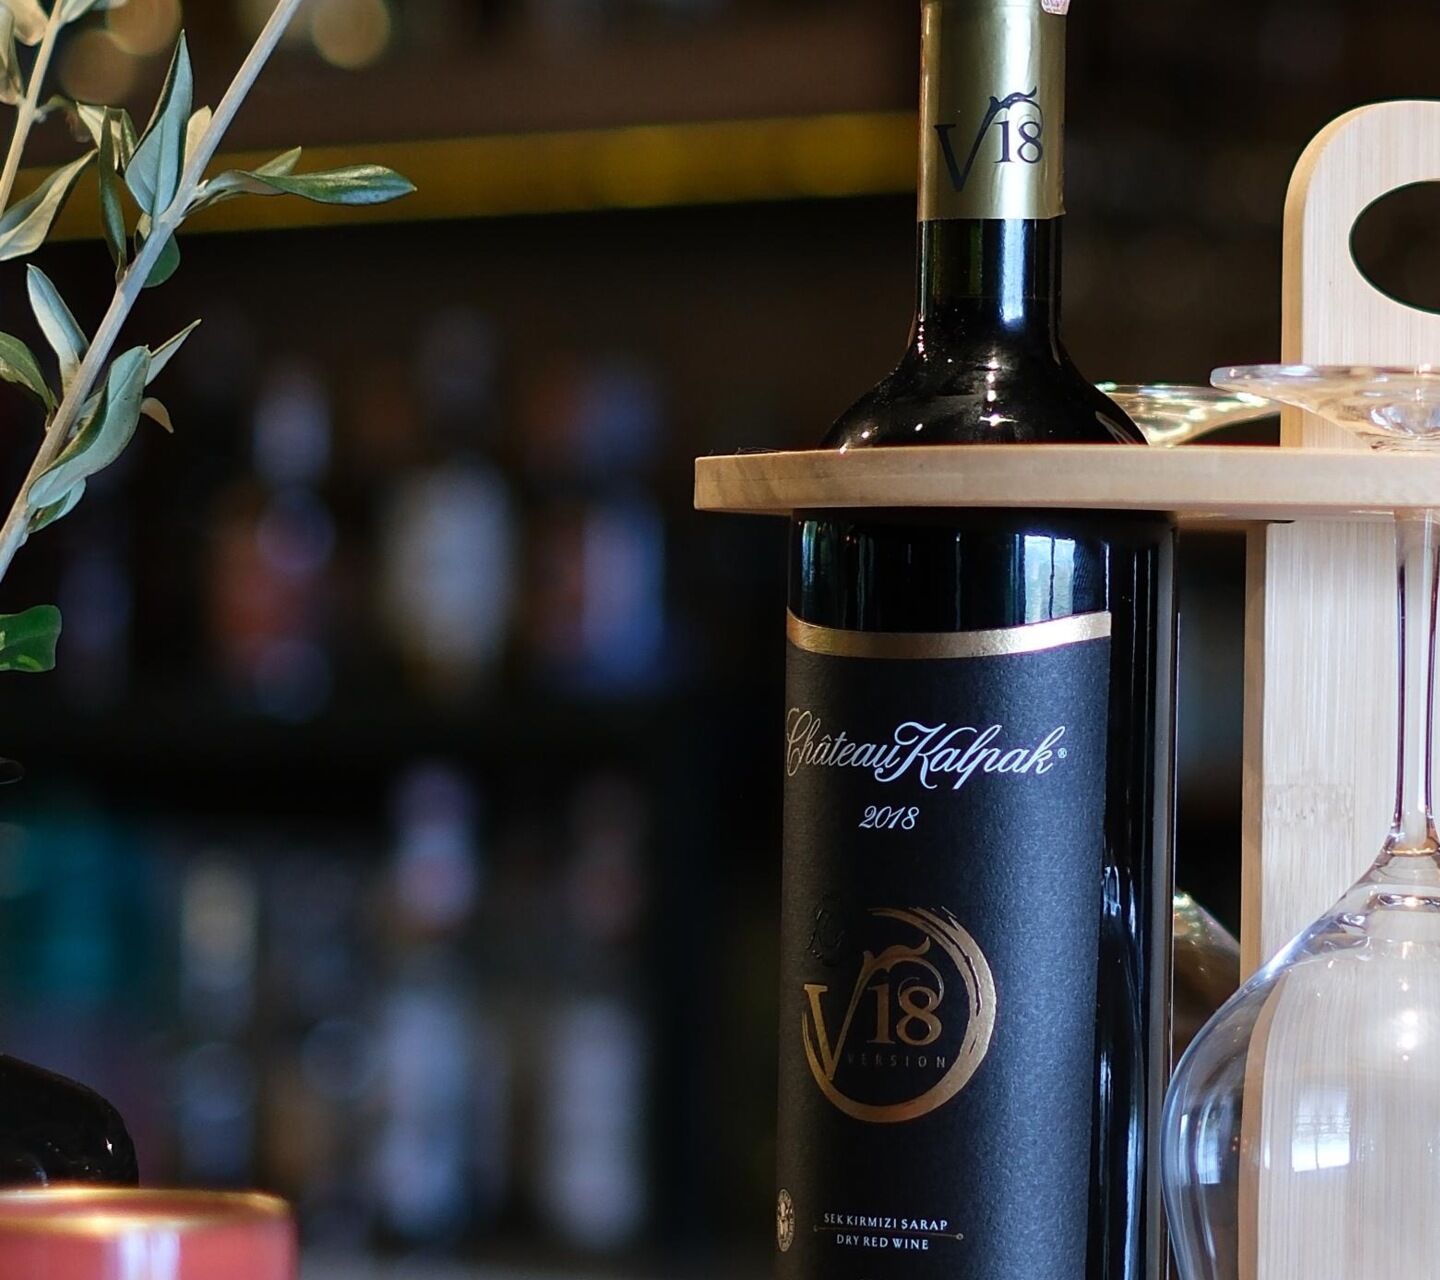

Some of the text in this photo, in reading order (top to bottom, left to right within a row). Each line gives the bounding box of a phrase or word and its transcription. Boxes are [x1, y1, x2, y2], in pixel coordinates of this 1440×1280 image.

[858, 805, 920, 830] 2018
[823, 1212, 844, 1225] SEK
[836, 1233, 929, 1251] DRY RED WINE
